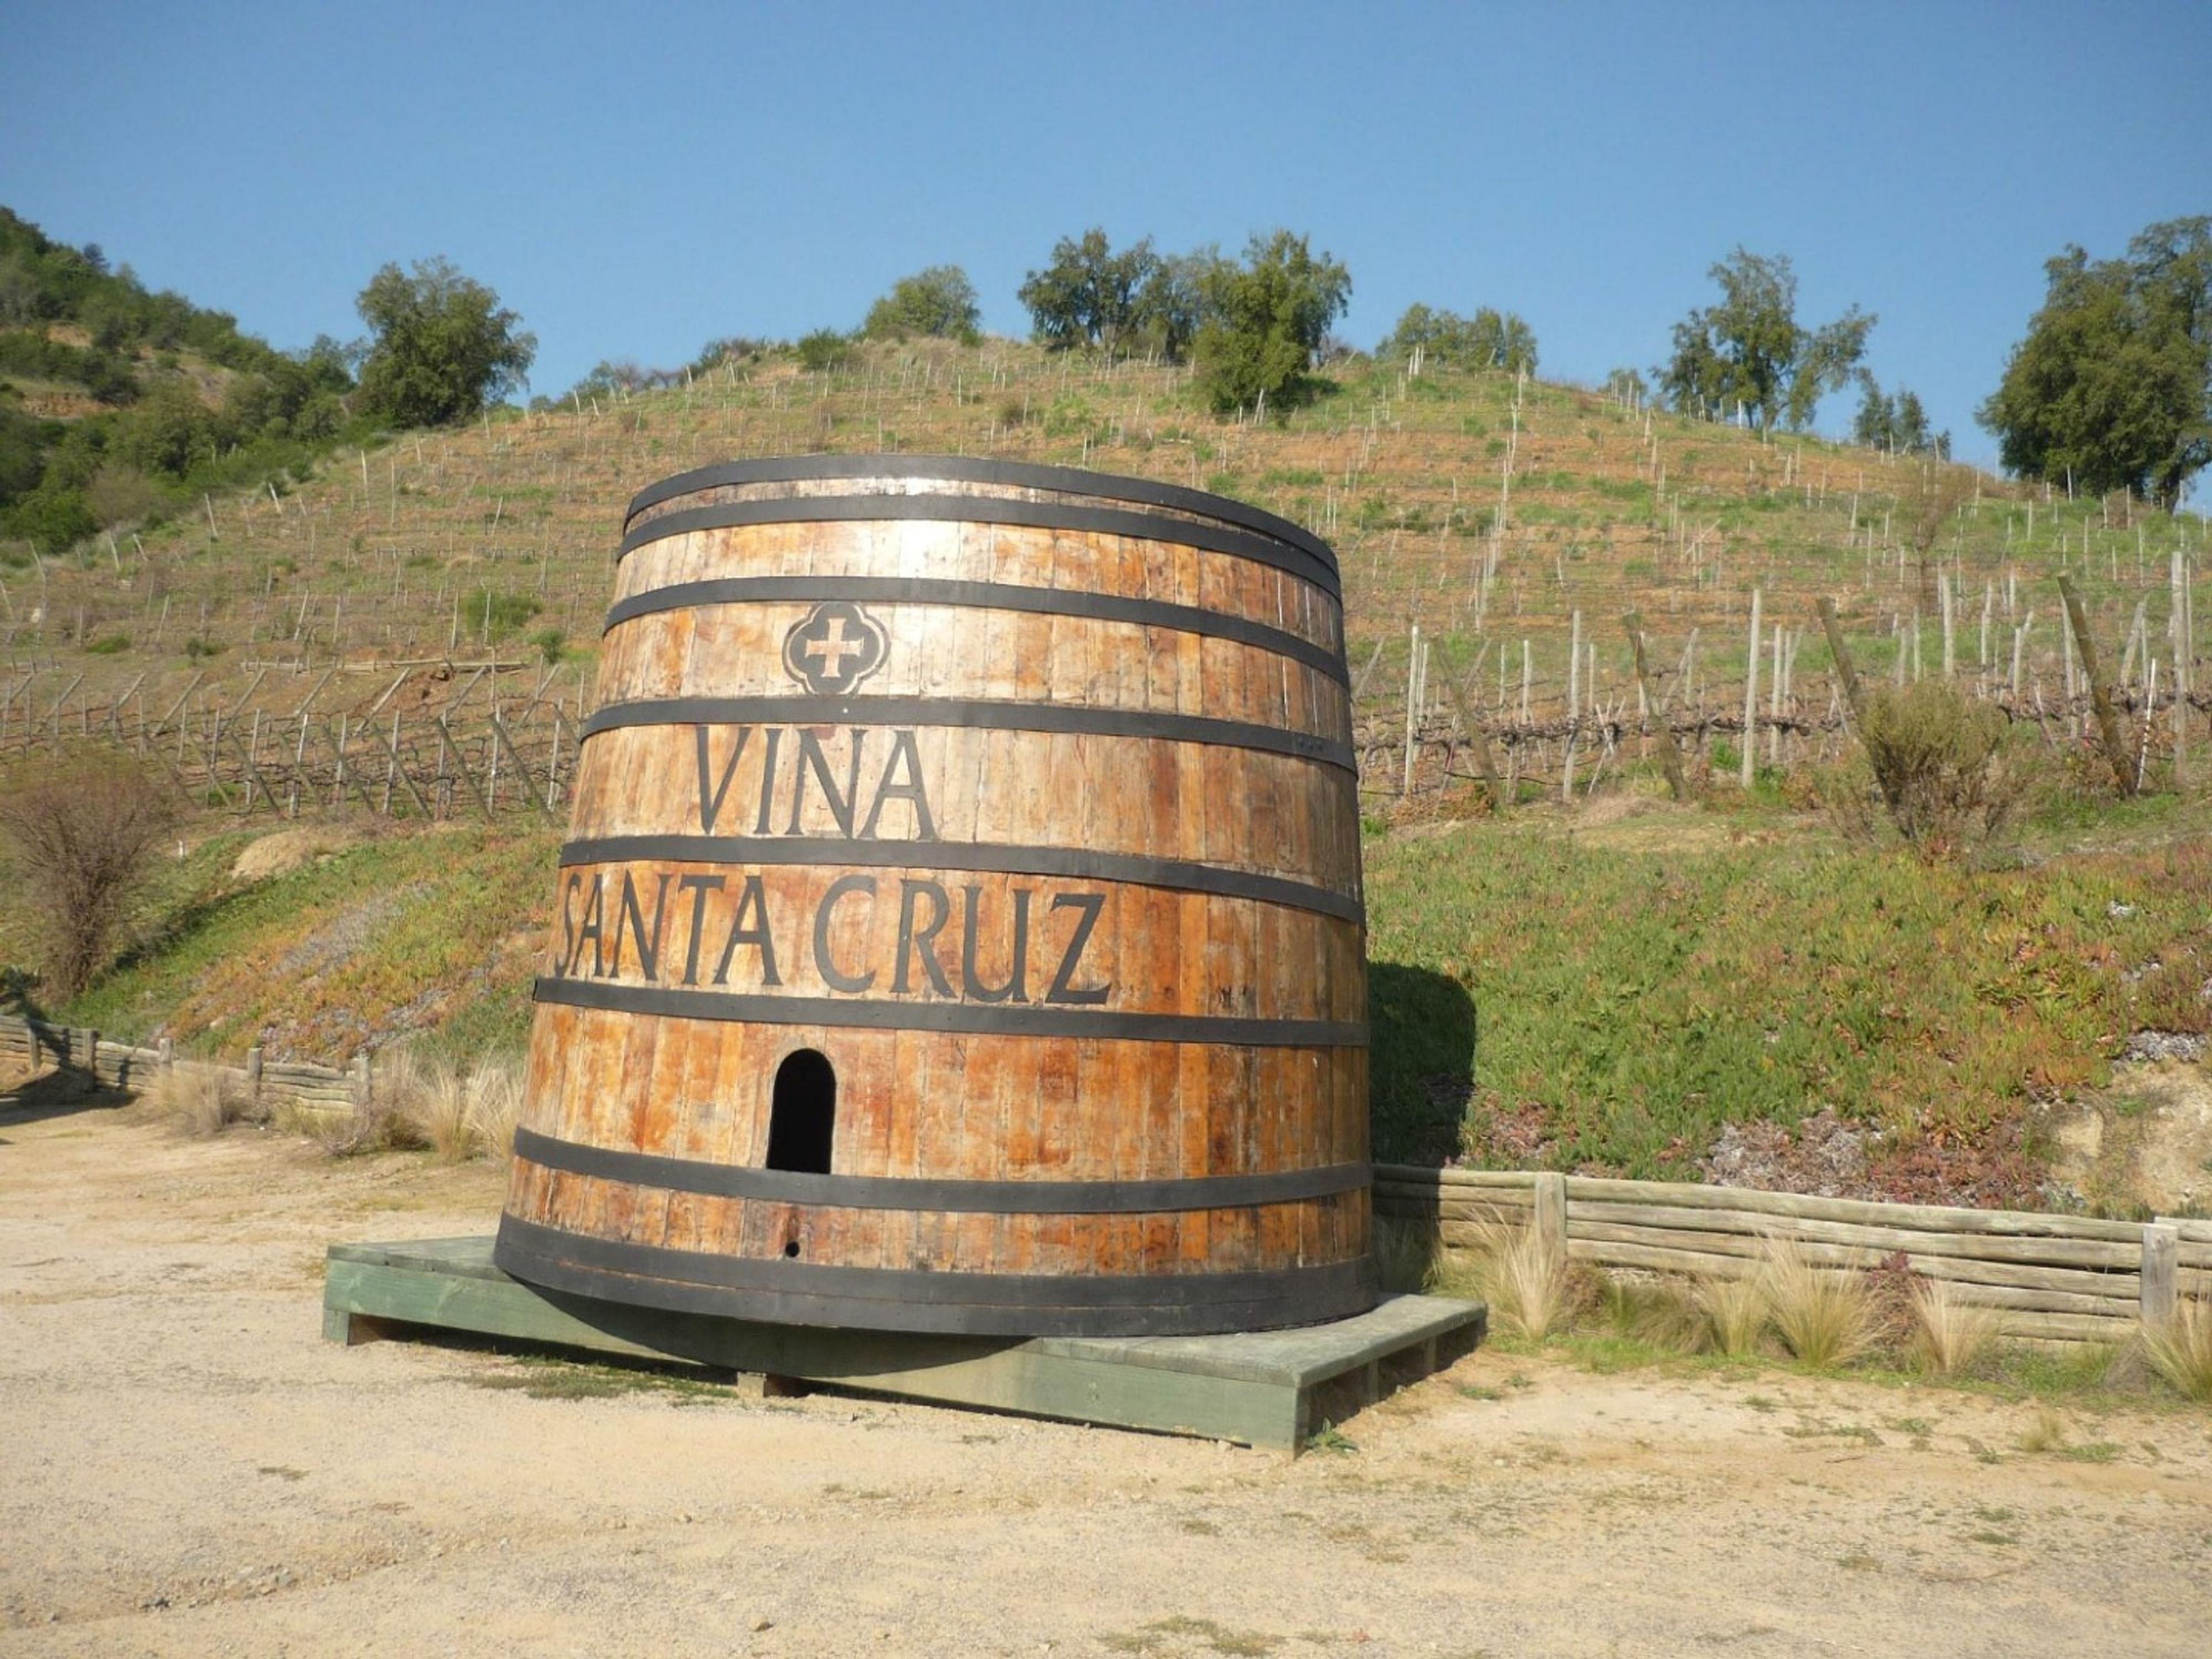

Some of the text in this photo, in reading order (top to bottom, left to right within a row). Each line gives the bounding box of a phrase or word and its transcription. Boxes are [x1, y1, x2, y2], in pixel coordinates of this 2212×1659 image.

[696, 726, 939, 840] VINA
[555, 870, 1111, 1003] SANTA CRUZ
